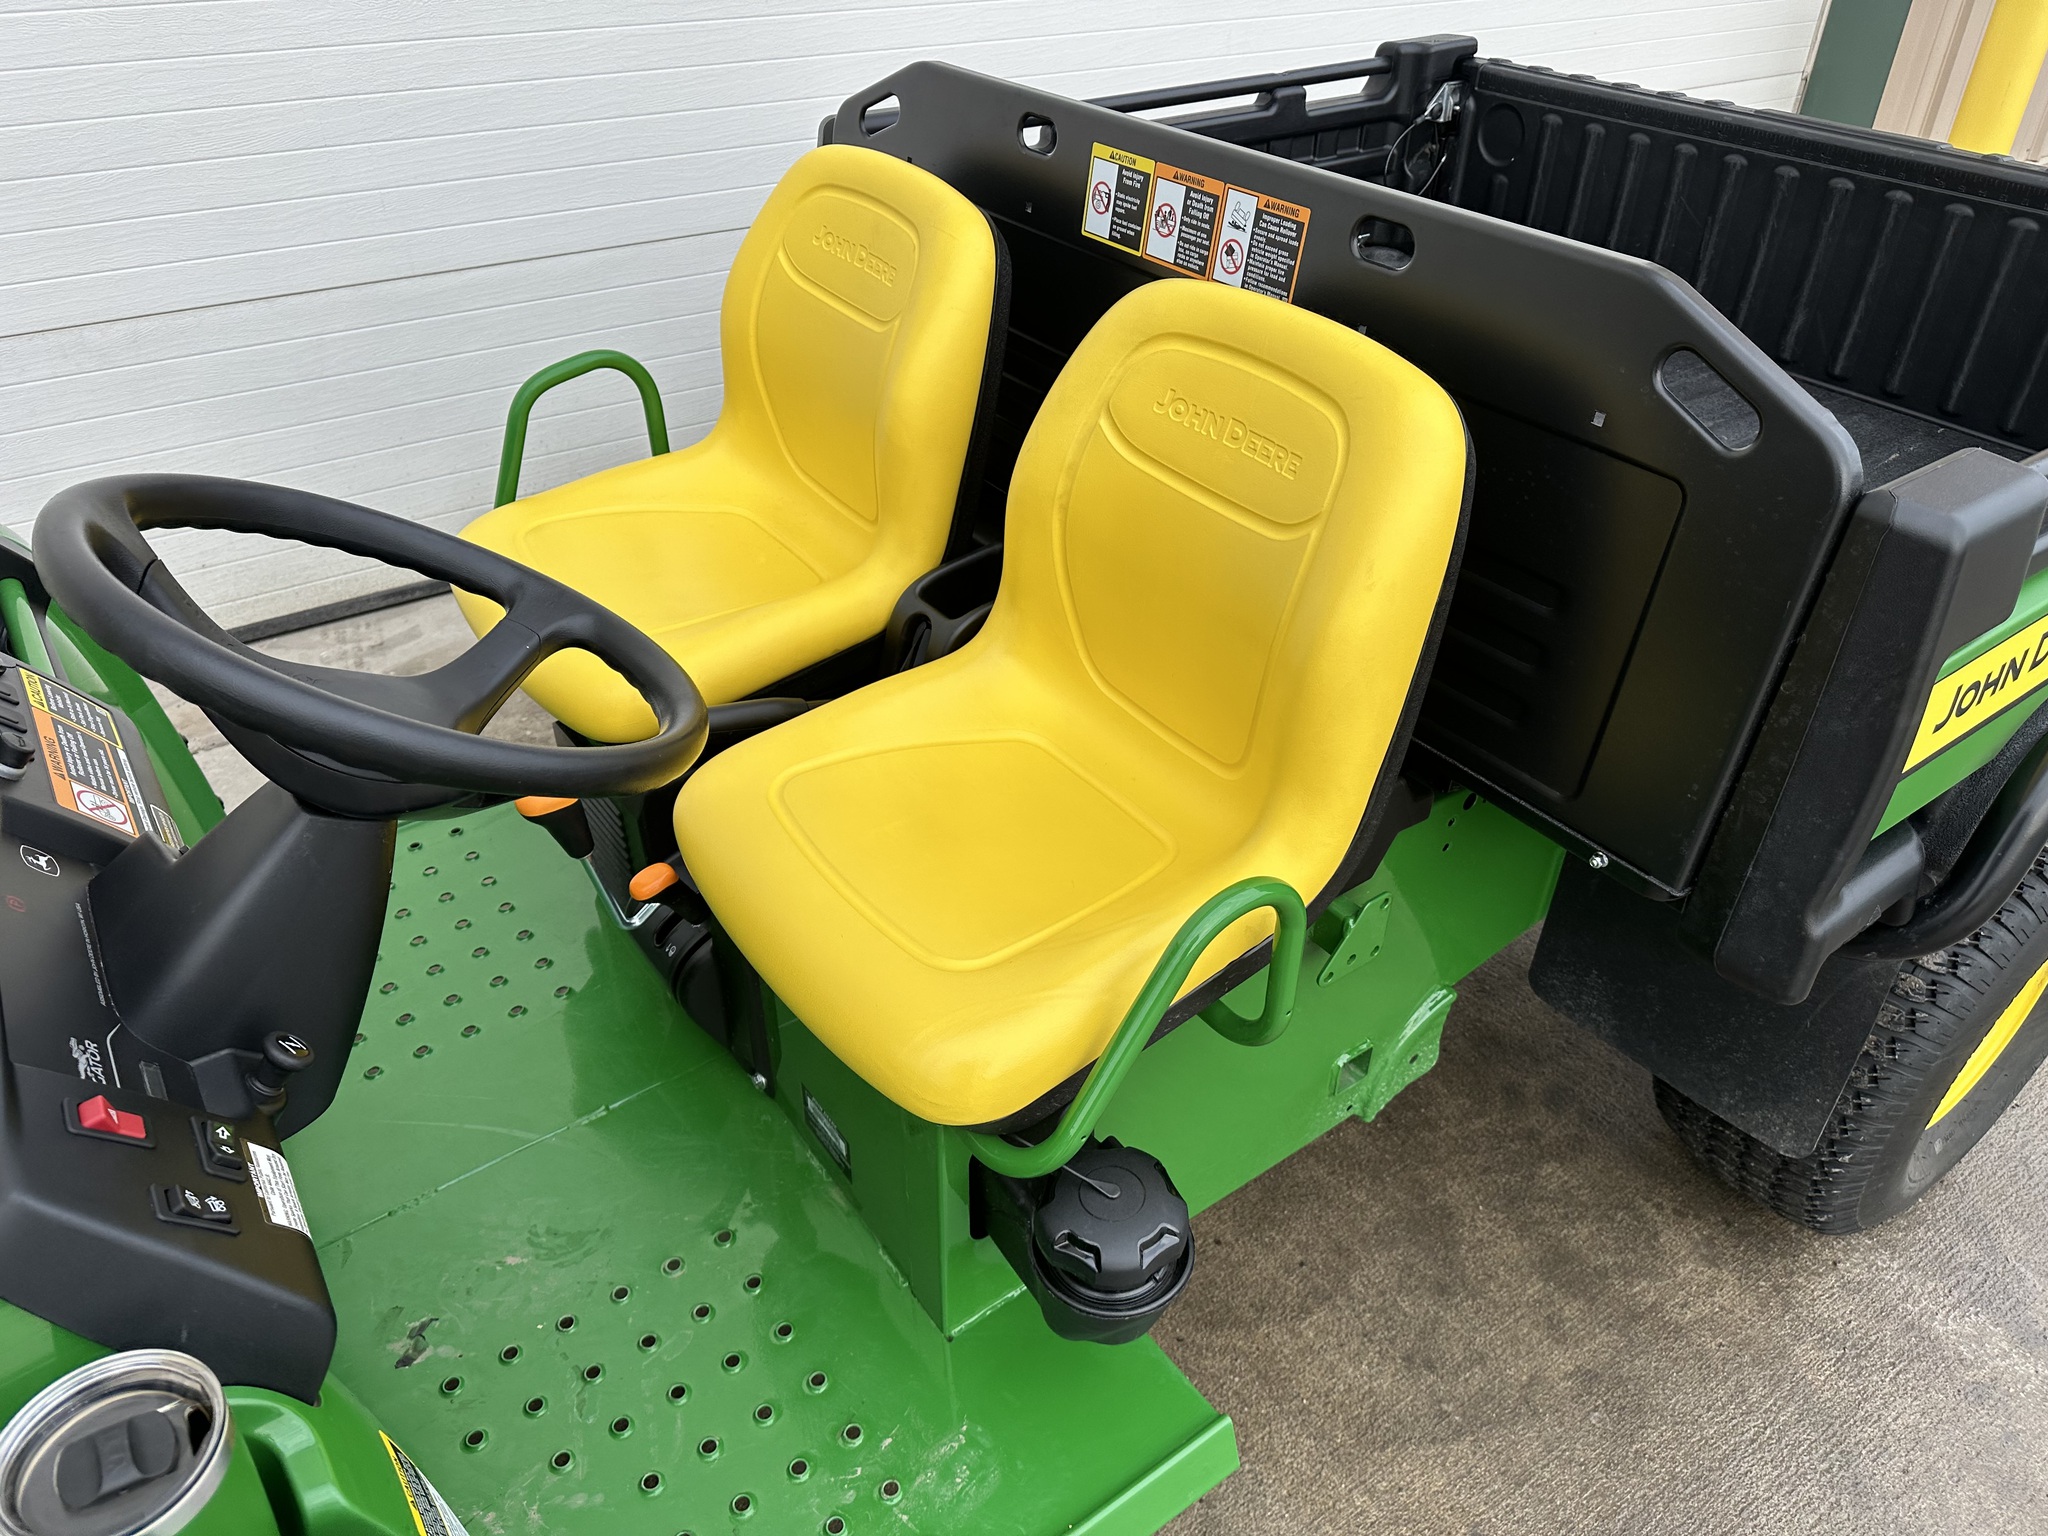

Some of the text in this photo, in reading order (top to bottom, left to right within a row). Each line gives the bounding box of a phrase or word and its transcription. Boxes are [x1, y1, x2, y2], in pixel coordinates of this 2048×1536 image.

[1114, 153, 1136, 165] CAUTION
[1180, 174, 1204, 187] WARNING
[1271, 202, 1299, 217] WARNING
[813, 224, 897, 287] JOHN DEERE
[1153, 388, 1303, 481] JOHN DEERE
[26, 673, 42, 701] CAUTION
[1932, 647, 2030, 735] JOHN
[44, 736, 62, 772] WARNING
